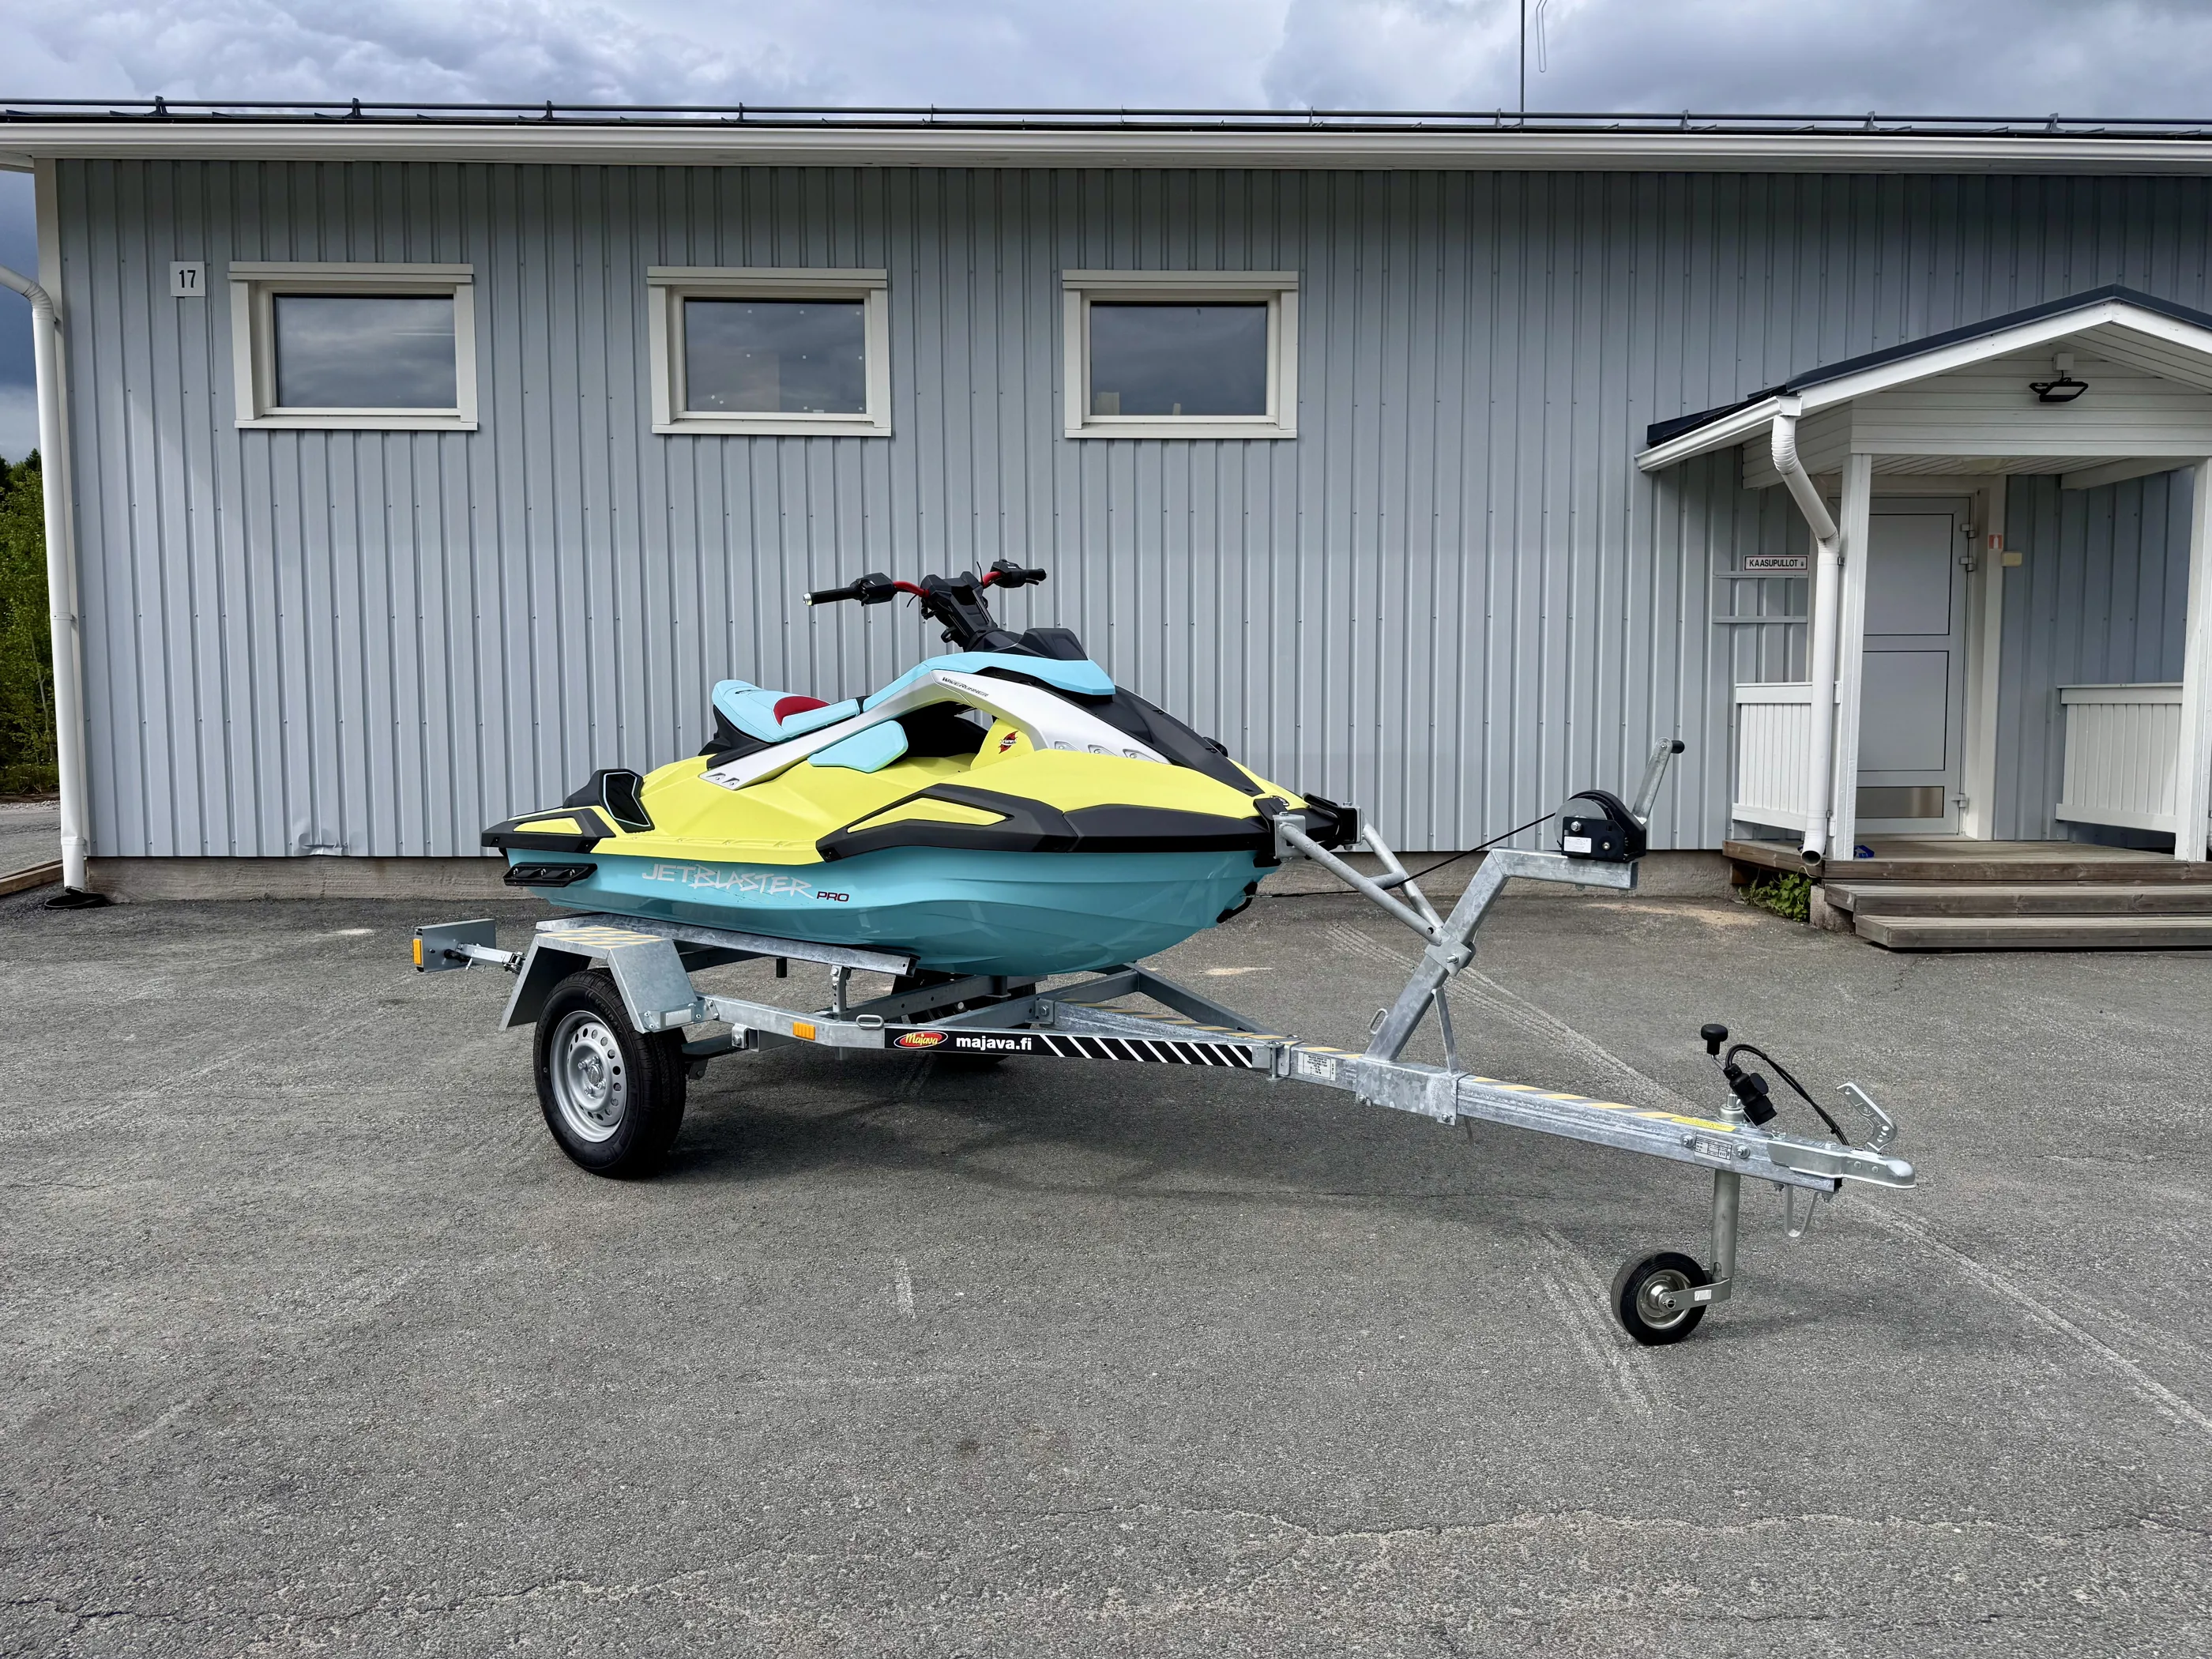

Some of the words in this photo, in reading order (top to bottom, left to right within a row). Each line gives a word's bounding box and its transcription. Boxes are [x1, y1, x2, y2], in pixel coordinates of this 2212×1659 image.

[179, 269, 196, 288] 17
[641, 863, 814, 899] JETBLASTER
[816, 891, 850, 902] PRO
[905, 1033, 939, 1046] Majava
[956, 1036, 1033, 1051] majava.fi
